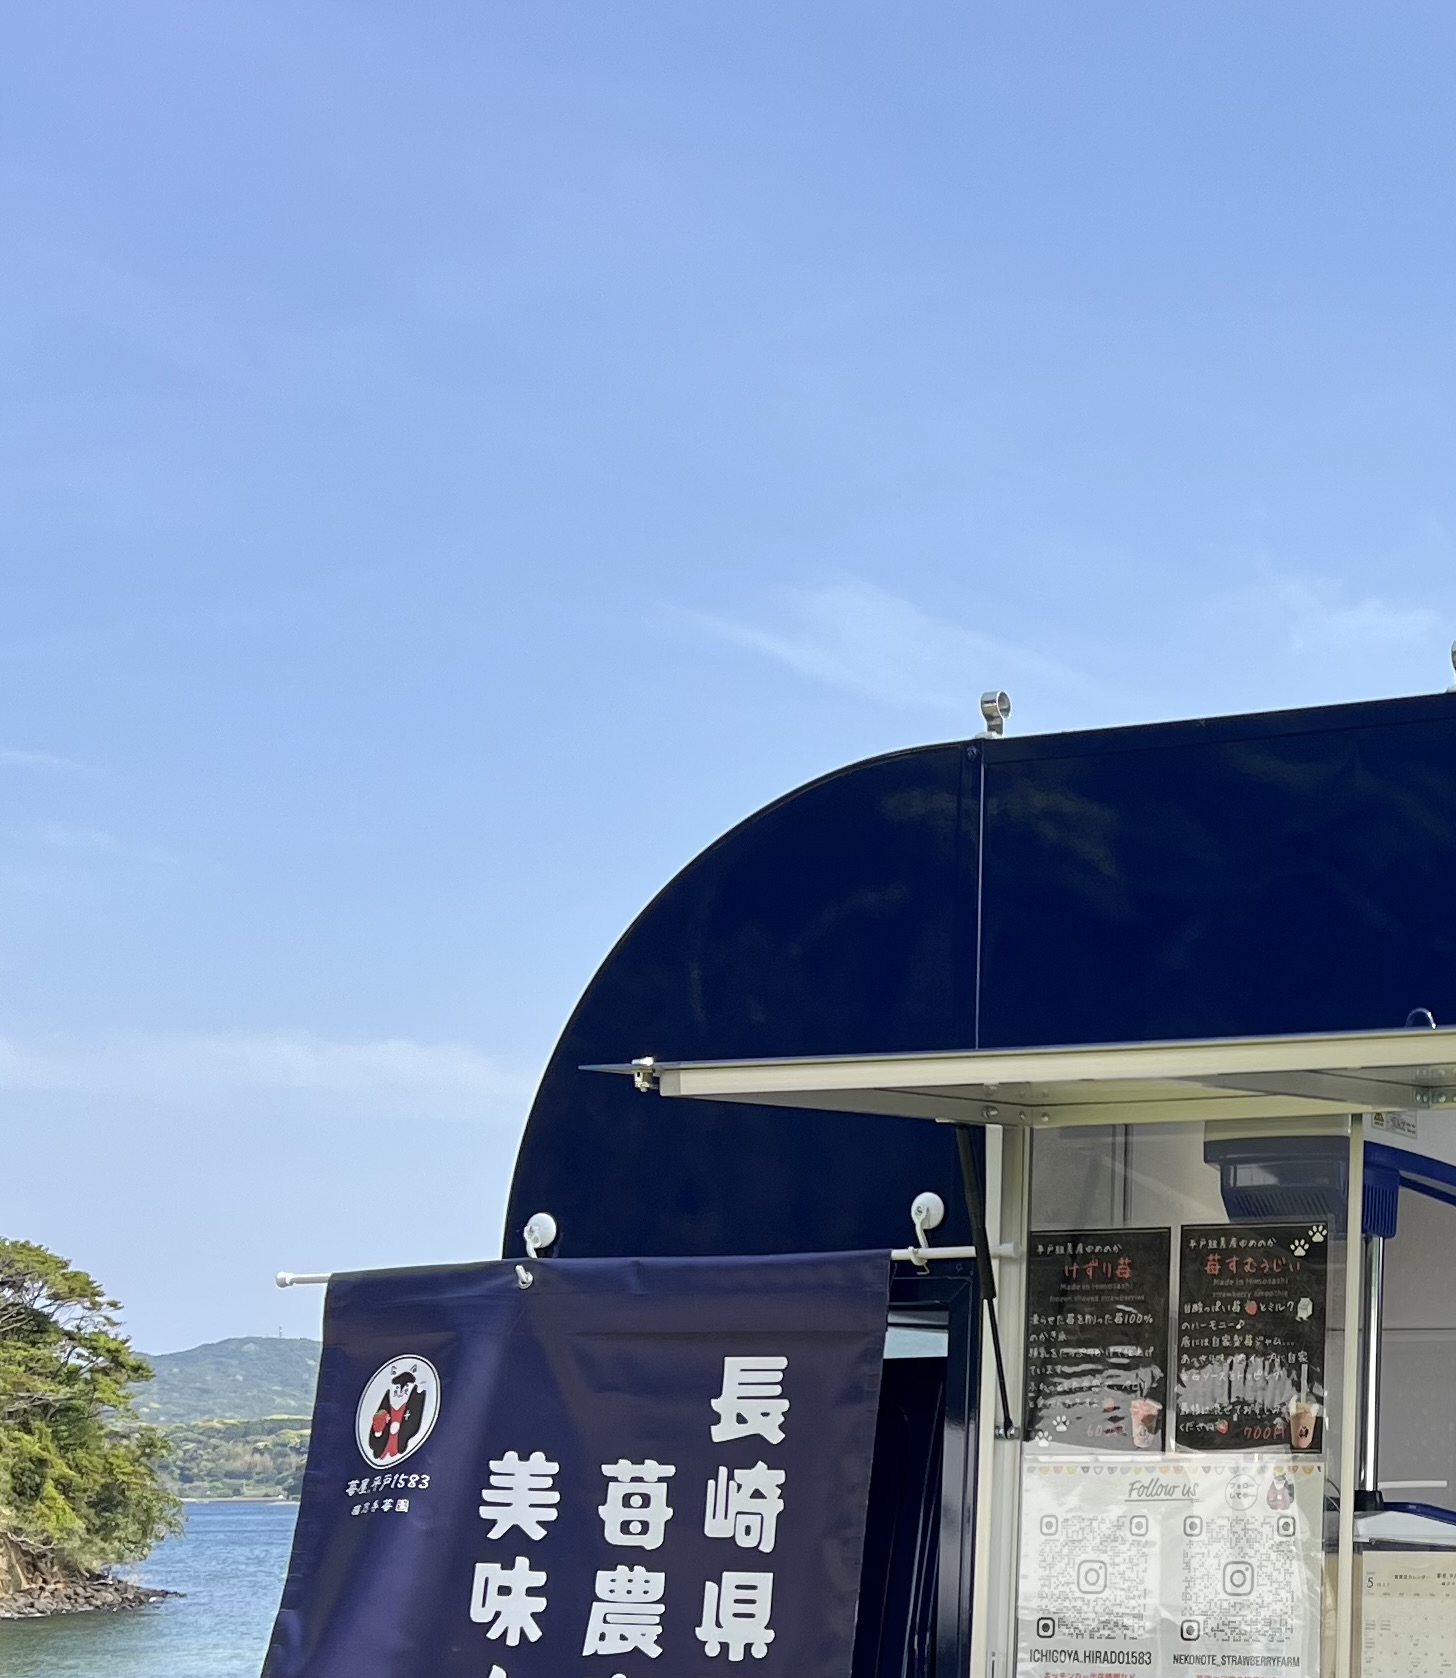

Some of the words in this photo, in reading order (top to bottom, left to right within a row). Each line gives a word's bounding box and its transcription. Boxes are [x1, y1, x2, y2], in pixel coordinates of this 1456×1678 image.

[1064, 1257, 1132, 1280] けずり苺
[1128, 1477, 1180, 1498] Follow
[1181, 1482, 1200, 1497] us
[1367, 1576, 1374, 1588] 5
[1029, 1648, 1152, 1666] ICHIGOYA.HIRADO1583
[1172, 1653, 1301, 1668] NEKONOTE_STRAWBERRYFARM
